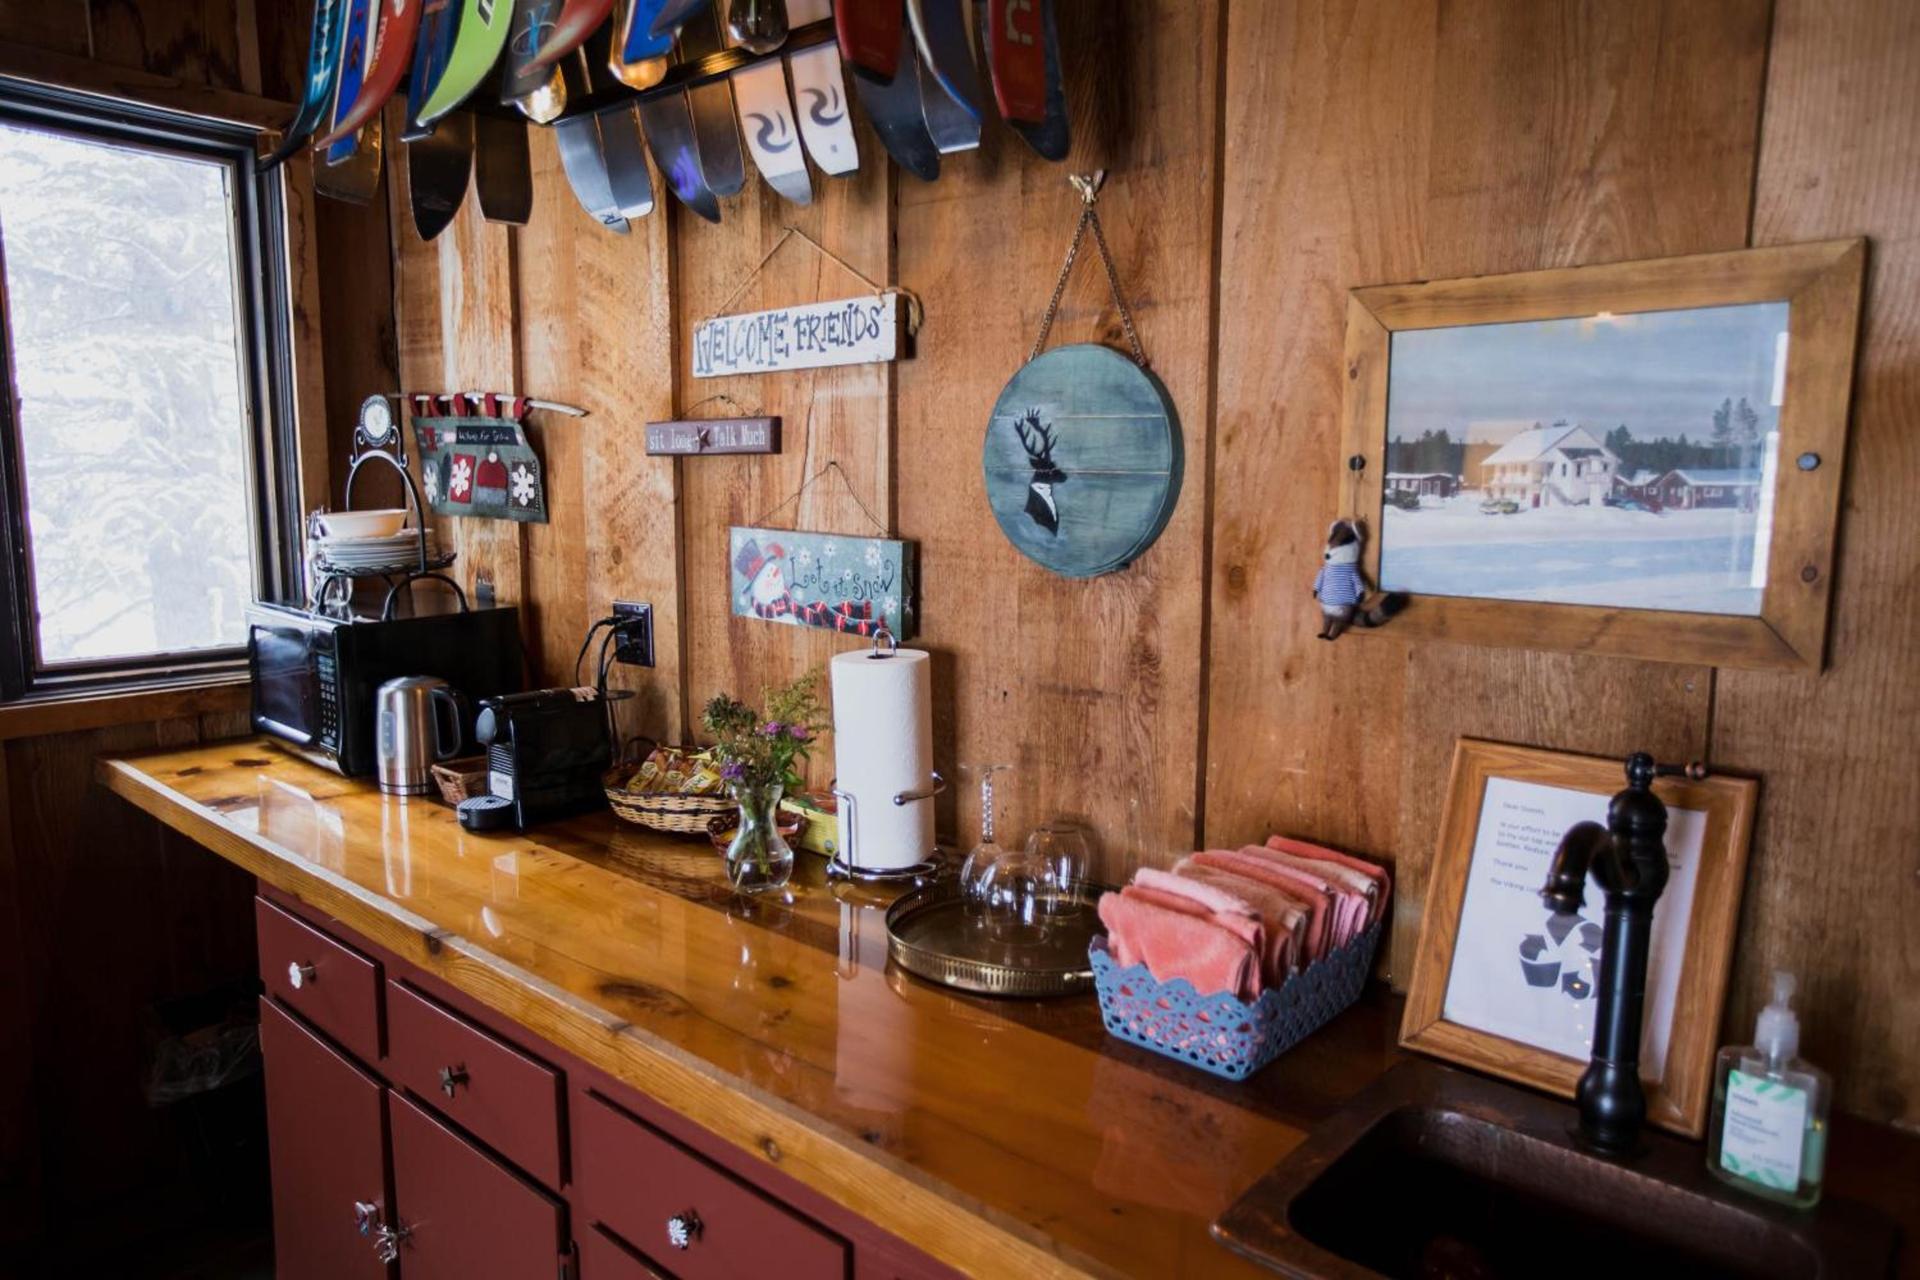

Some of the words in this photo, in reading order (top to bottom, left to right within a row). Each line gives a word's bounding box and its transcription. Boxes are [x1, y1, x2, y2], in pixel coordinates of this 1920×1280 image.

[696, 311, 789, 374] WELCOME
[793, 302, 884, 353] FRIENDS
[789, 556, 830, 594] Let
[853, 559, 895, 601] Snow
